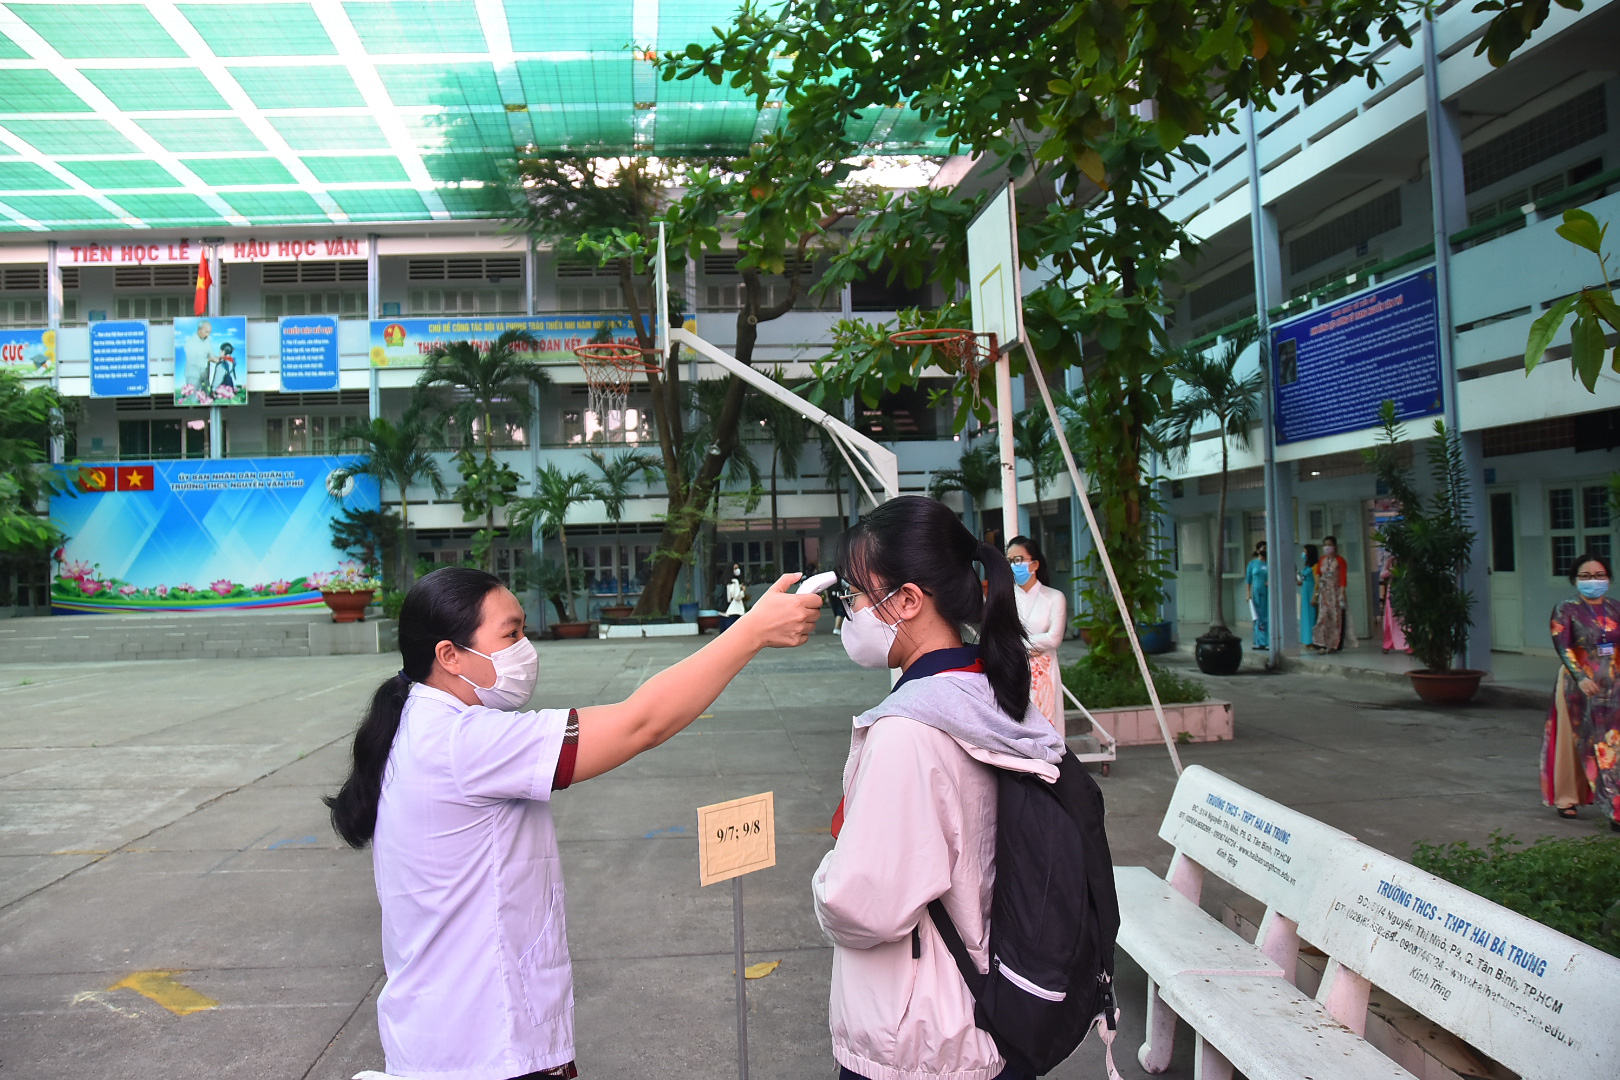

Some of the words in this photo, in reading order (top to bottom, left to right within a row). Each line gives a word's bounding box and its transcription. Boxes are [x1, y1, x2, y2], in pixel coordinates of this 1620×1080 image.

[70, 242, 112, 262] TIÊN
[120, 244, 159, 265] HỌC
[168, 238, 190, 260] LỄ
[233, 238, 270, 262] HẬU
[278, 240, 316, 260] HỌC
[324, 236, 358, 255] VĂN
[1224, 802, 1239, 817] THCS
[1242, 810, 1256, 826] THPT
[1254, 818, 1265, 831] HAI
[716, 826, 739, 844] 9/7;
[743, 820, 760, 837] 9/8
[1376, 880, 1412, 908] TRƯỜNG
[1412, 896, 1438, 920] THCS
[1444, 912, 1472, 937] THPT
[1470, 926, 1491, 948] HAI
[1507, 944, 1548, 978] TRƯNG
[1386, 910, 1414, 930] Nguyễn
[1476, 958, 1494, 976] Tân
[1522, 982, 1564, 1014] TP.HCM
